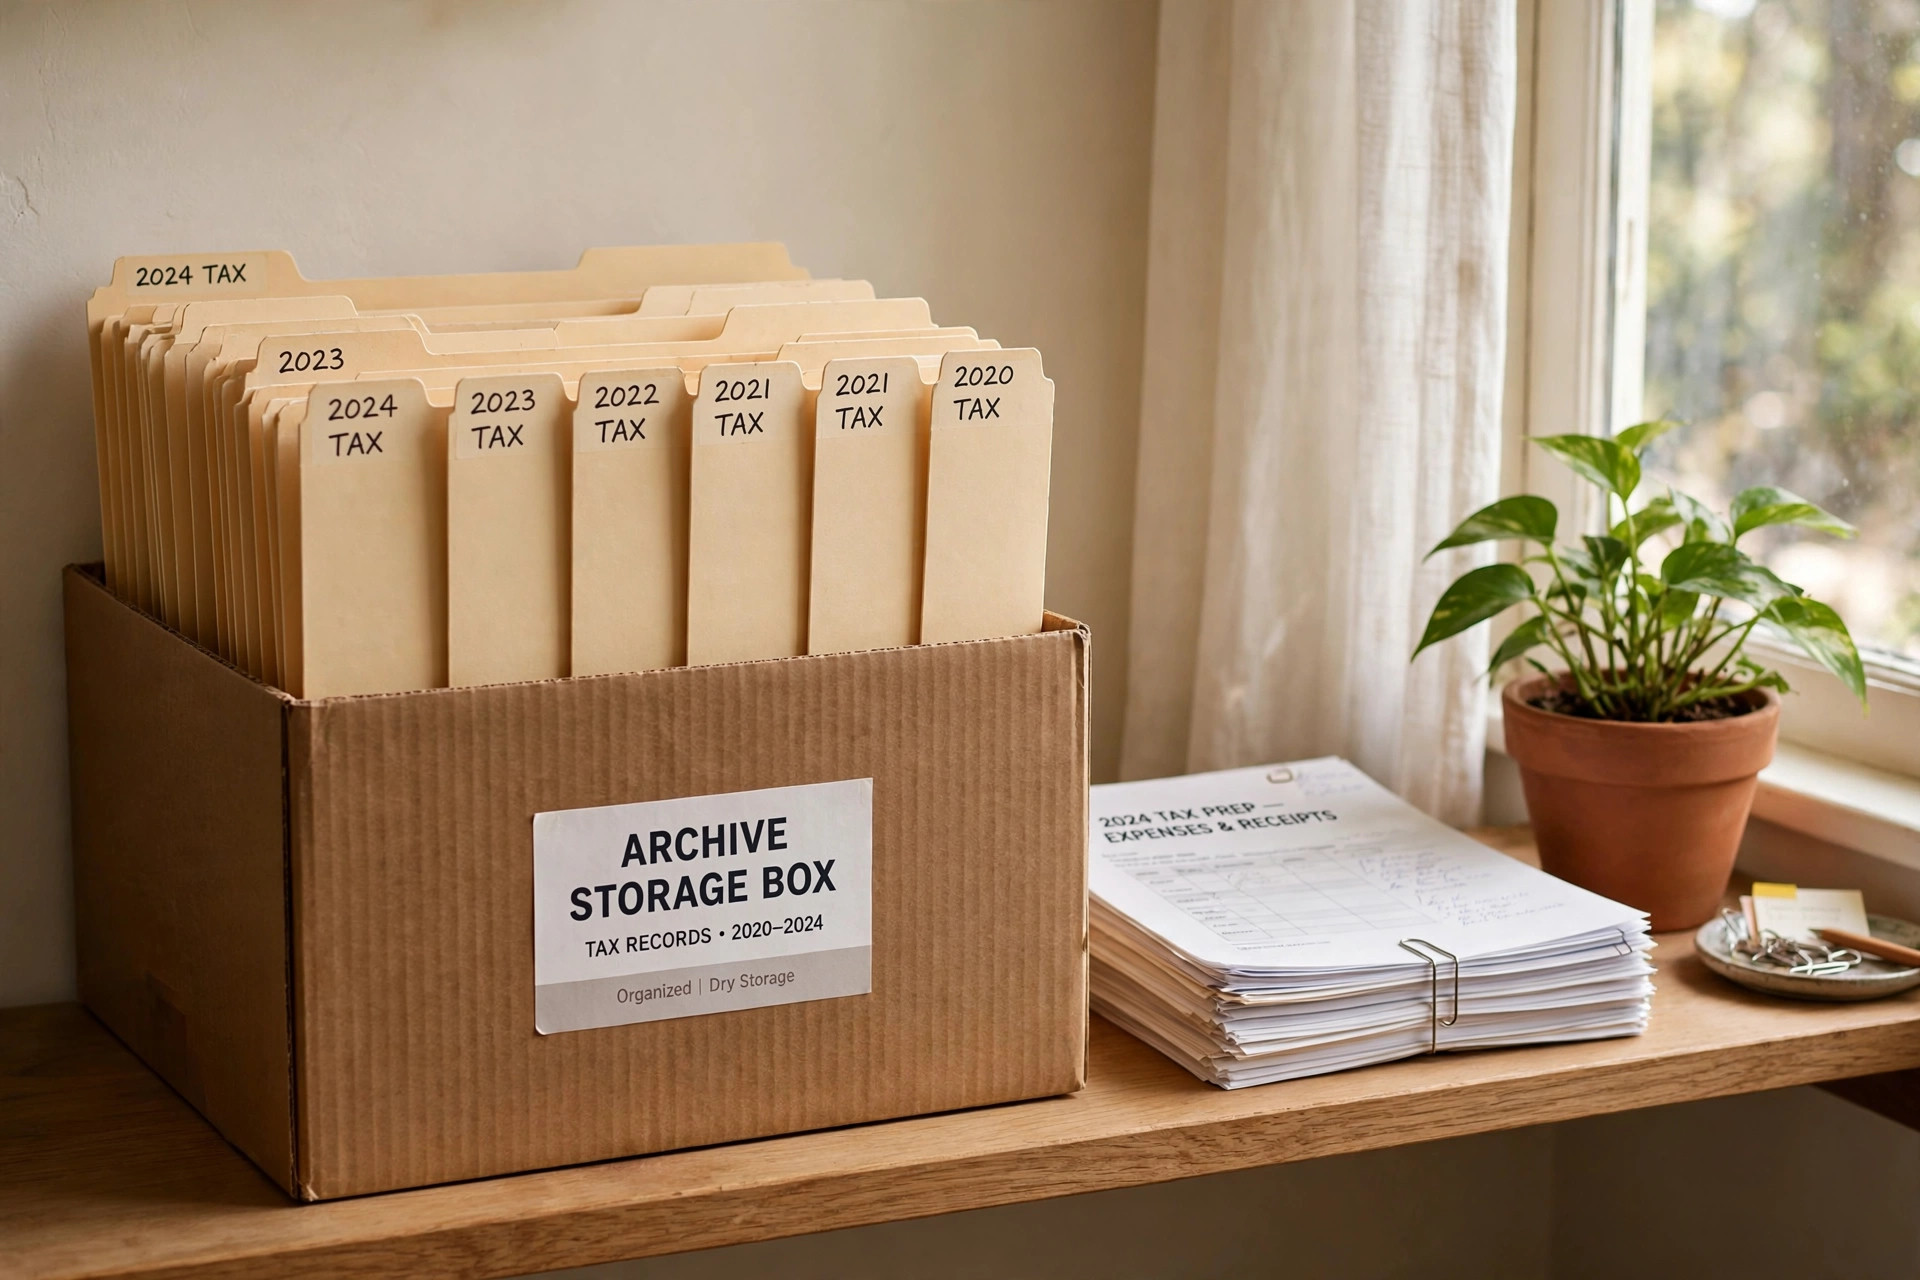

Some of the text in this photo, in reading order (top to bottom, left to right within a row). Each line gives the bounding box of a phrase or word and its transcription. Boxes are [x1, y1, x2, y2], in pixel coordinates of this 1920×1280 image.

[137, 264, 246, 286] 2024 TAX
[279, 348, 344, 373] 2023
[836, 373, 888, 396] 2021
[954, 366, 1013, 387] 2020
[471, 389, 535, 414] 2023
[595, 384, 659, 409] 2022
[715, 378, 769, 402] 2021
[328, 394, 398, 421] 2024
[836, 406, 883, 429] TAX
[953, 397, 1000, 420] TAX
[471, 424, 523, 449] TAX
[595, 418, 645, 443] TAX
[715, 412, 763, 436] TAX
[329, 431, 382, 456] TAX
[1099, 813, 1152, 827] 2024
[1154, 808, 1200, 822] TAX
[1201, 802, 1255, 817] PREP
[1104, 810, 1338, 843] EXPENSES & RECEIPTS
[621, 817, 788, 868] ARCHIVE
[570, 859, 837, 921] STORAGE BOX
[585, 938, 620, 958] TAX
[626, 927, 712, 953] RECORDS
[617, 980, 692, 1004] Organized
[709, 976, 735, 994] Dry
[740, 970, 795, 989] Storage
